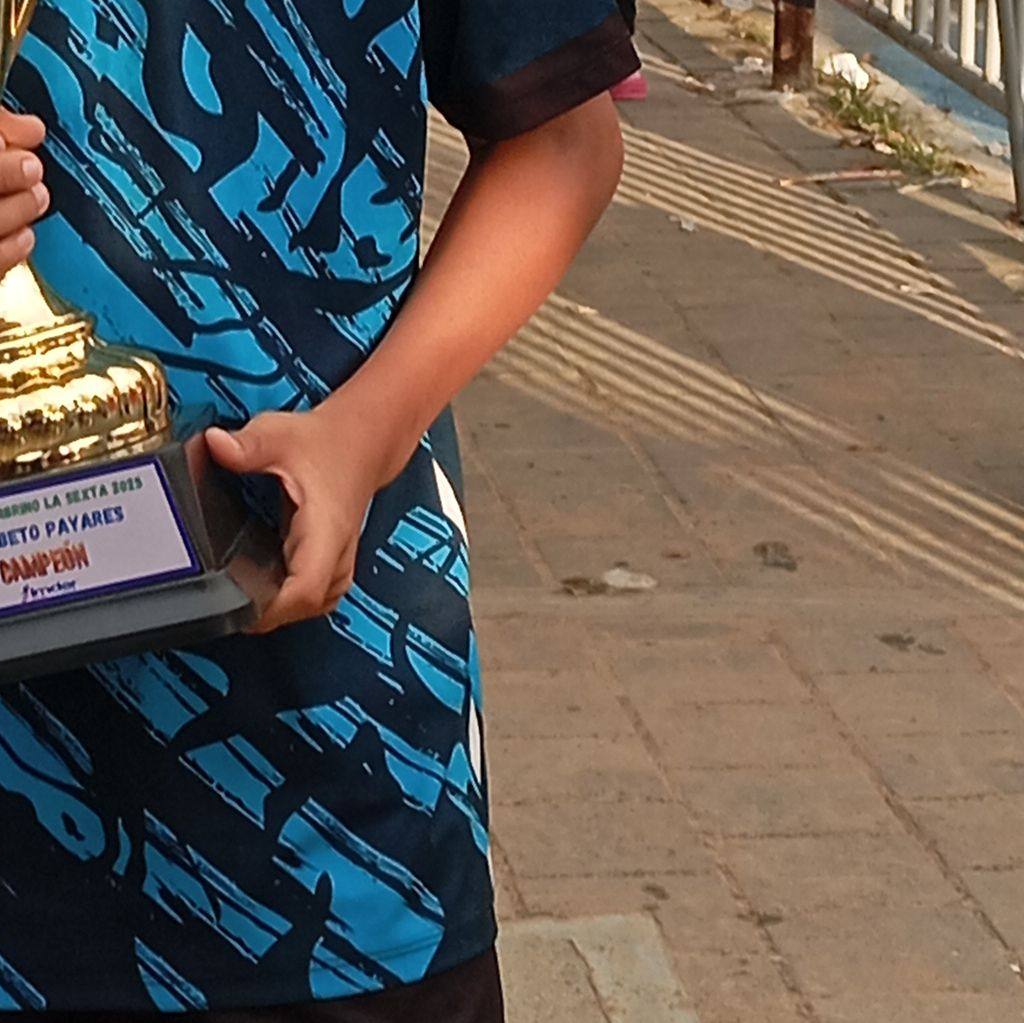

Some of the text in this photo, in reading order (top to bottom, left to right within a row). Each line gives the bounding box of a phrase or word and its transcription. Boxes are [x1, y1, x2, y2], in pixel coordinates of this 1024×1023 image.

[43, 494, 62, 510] LA
[65, 484, 108, 505] SEXTA
[45, 505, 125, 539] PAYARES
